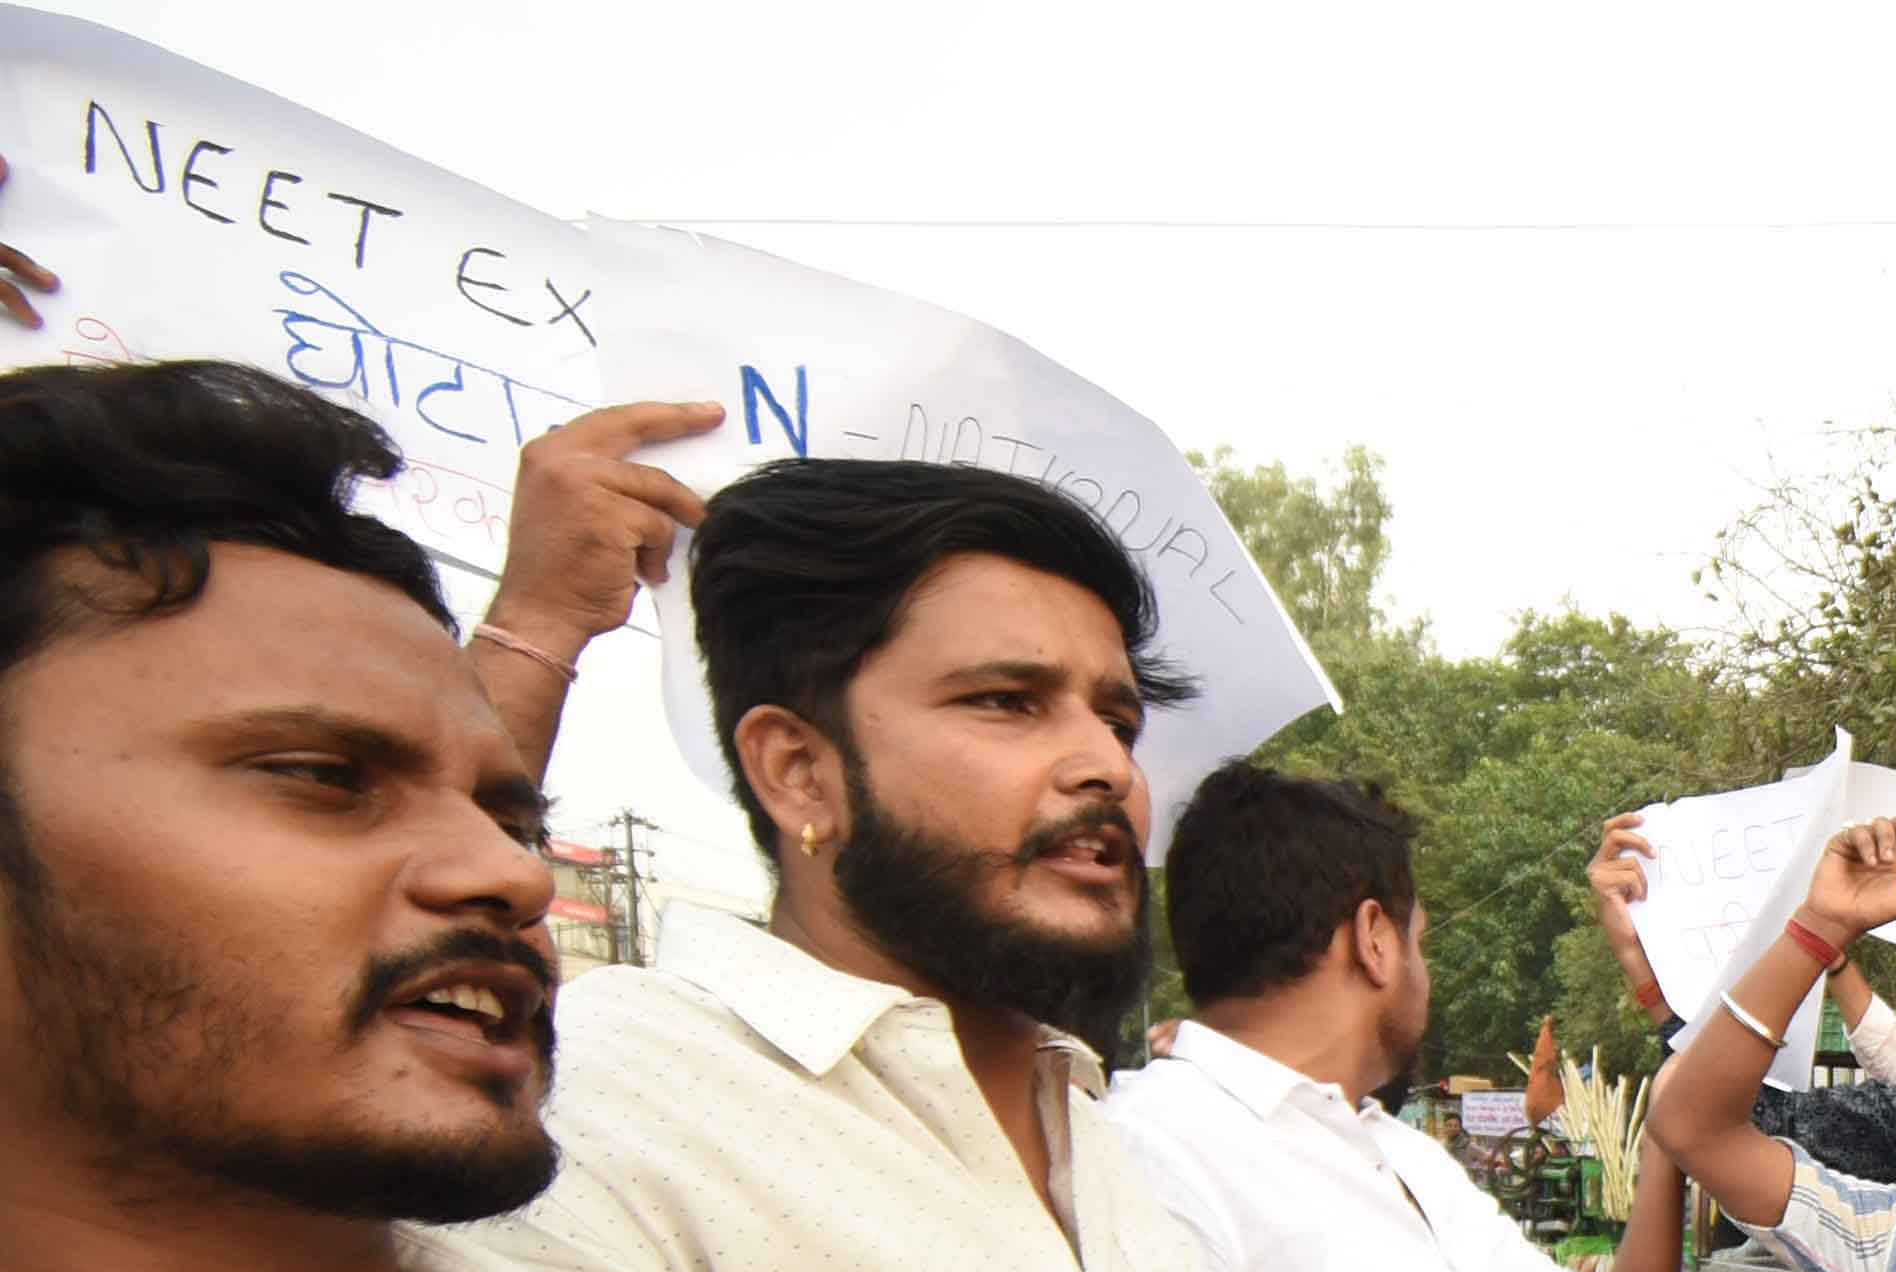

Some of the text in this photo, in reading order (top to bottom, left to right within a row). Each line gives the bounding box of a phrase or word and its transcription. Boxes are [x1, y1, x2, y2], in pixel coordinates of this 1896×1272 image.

[85, 100, 403, 269] NEET
[272, 271, 593, 447] घोटा
[738, 364, 807, 458] N
